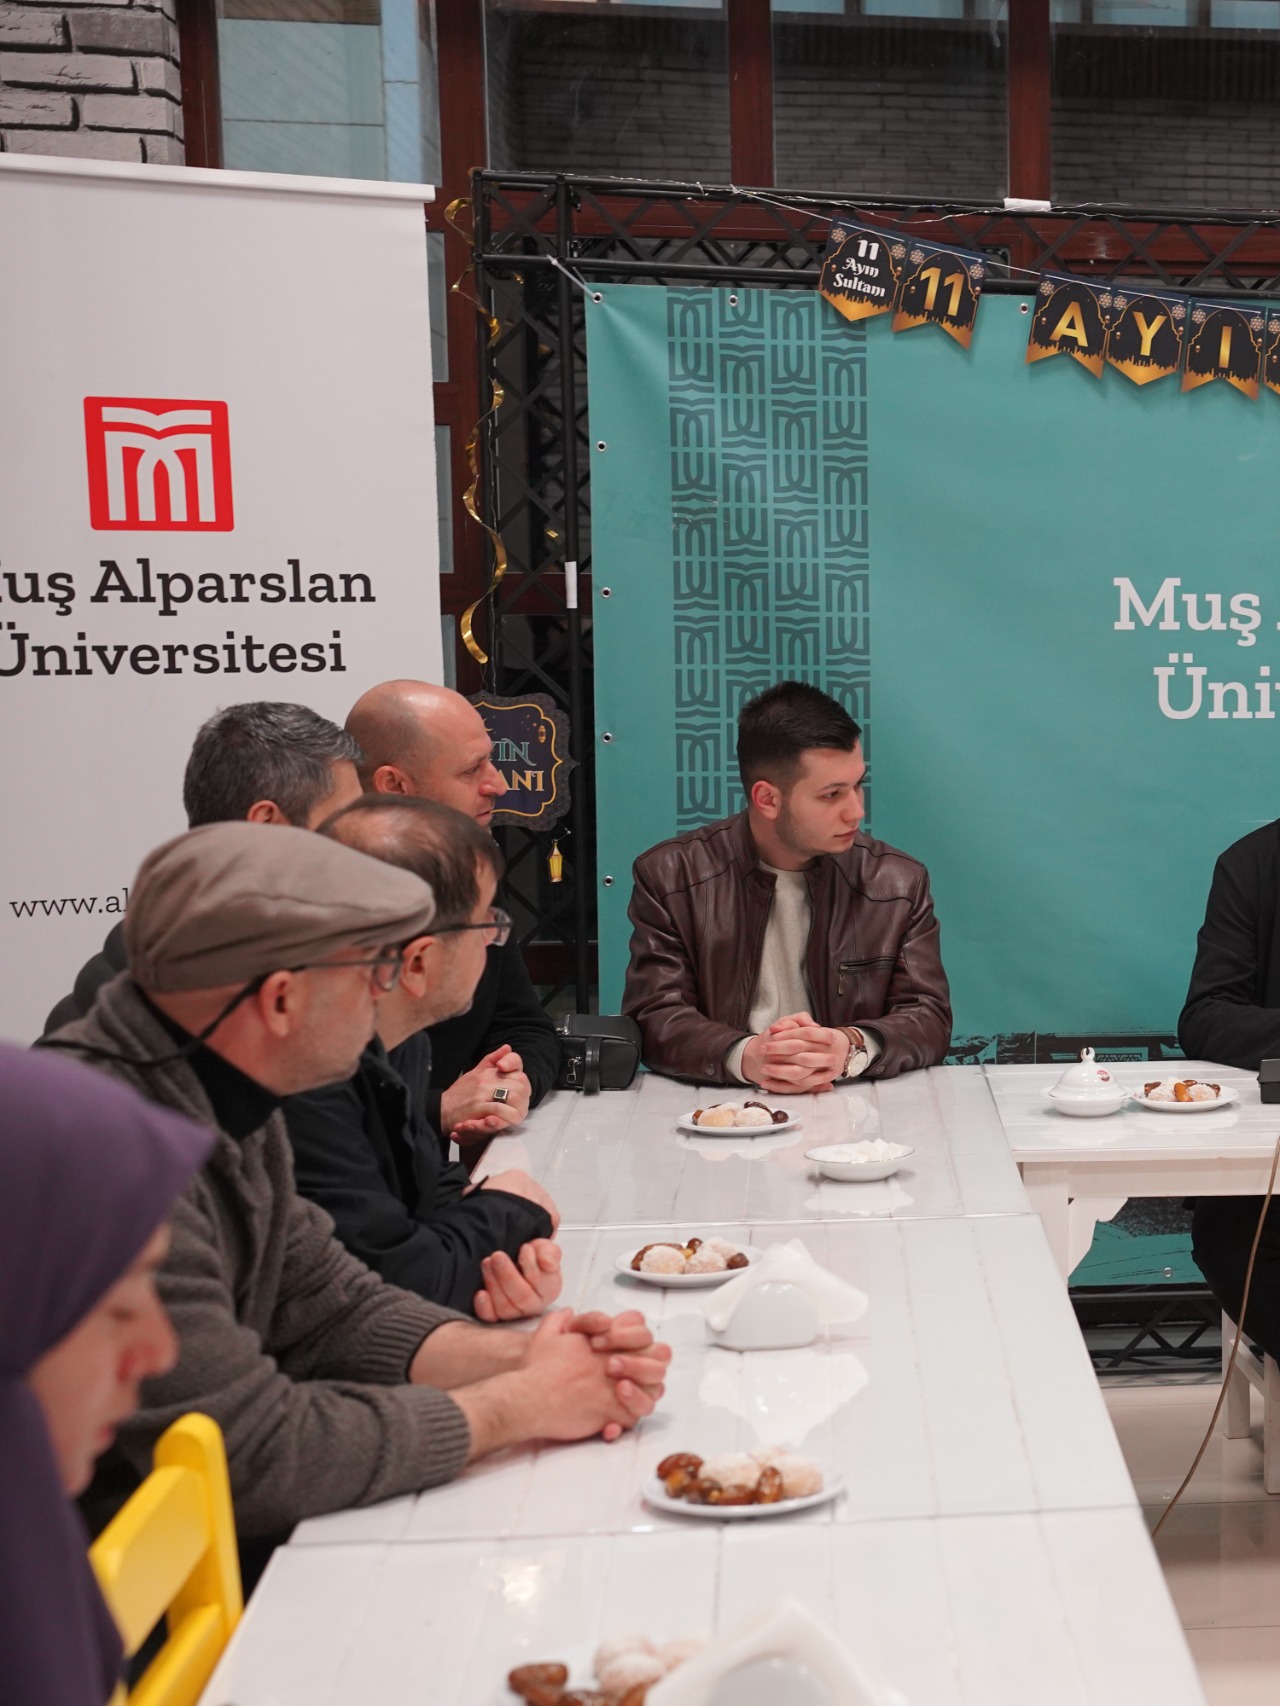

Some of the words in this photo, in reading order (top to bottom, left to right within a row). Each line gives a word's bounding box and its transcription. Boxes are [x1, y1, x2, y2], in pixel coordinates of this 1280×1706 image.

[857, 239, 880, 260] 11
[920, 266, 965, 317] 11
[0, 560, 76, 616] uş
[90, 557, 376, 616] Alparslan
[1113, 577, 1262, 647] Muş
[0, 621, 347, 677] Üniversitesi
